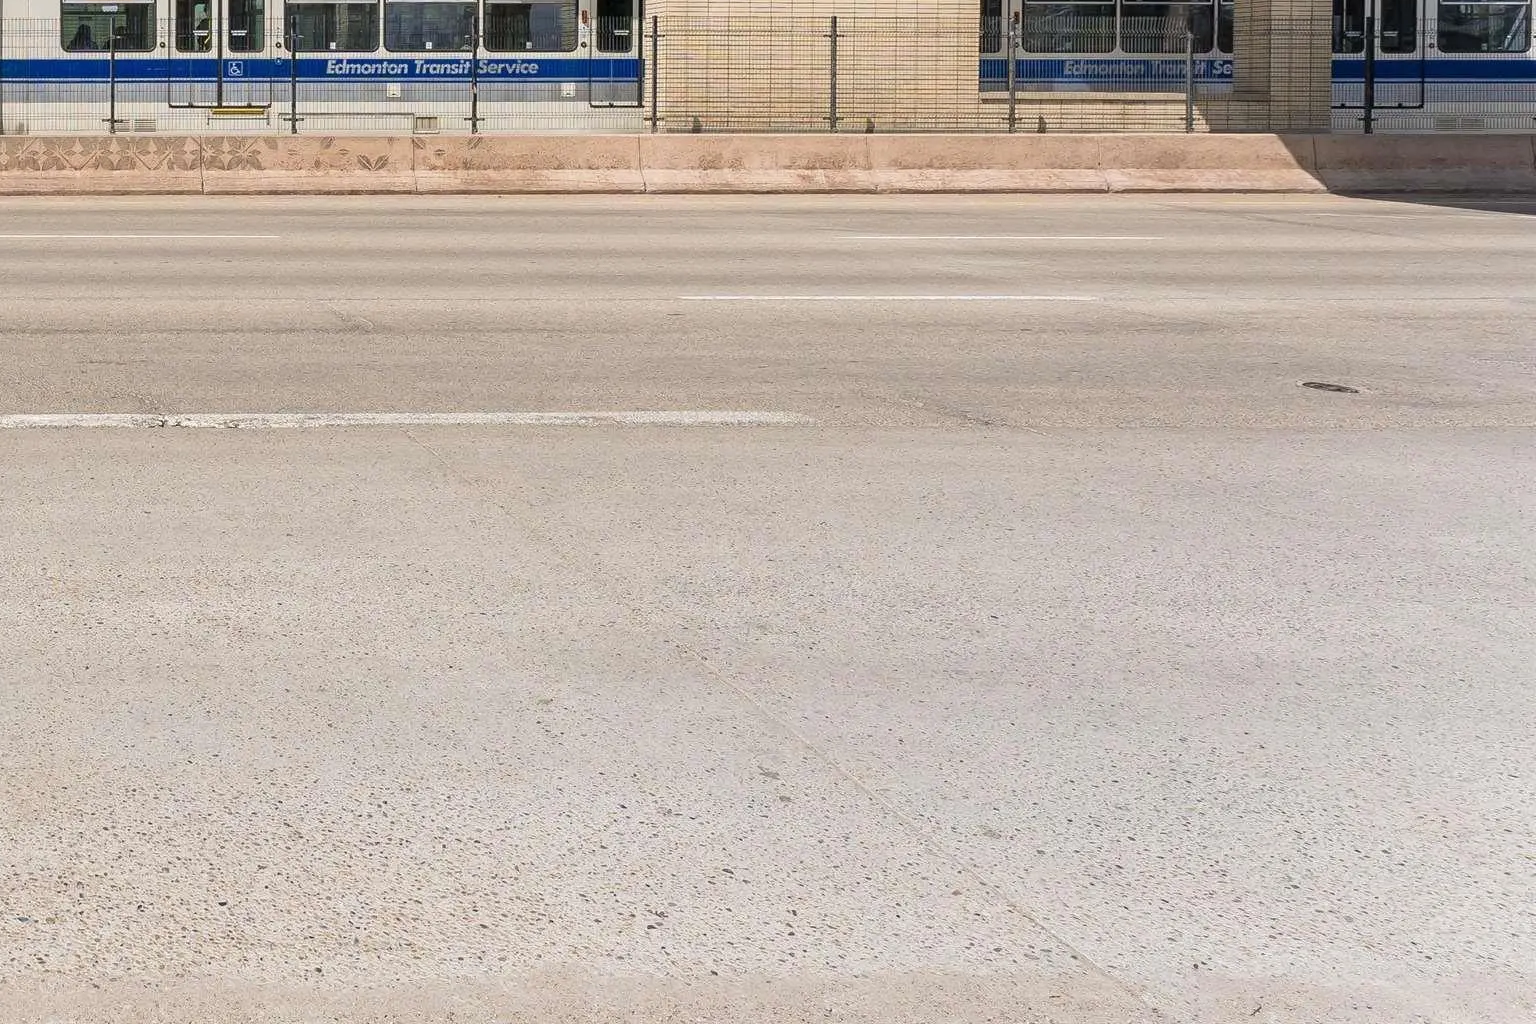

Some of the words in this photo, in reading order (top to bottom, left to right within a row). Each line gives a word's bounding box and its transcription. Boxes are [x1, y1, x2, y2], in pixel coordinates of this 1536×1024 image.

[326, 59, 408, 75] Edmonton
[414, 59, 471, 75] Transit
[477, 59, 539, 74] Service
